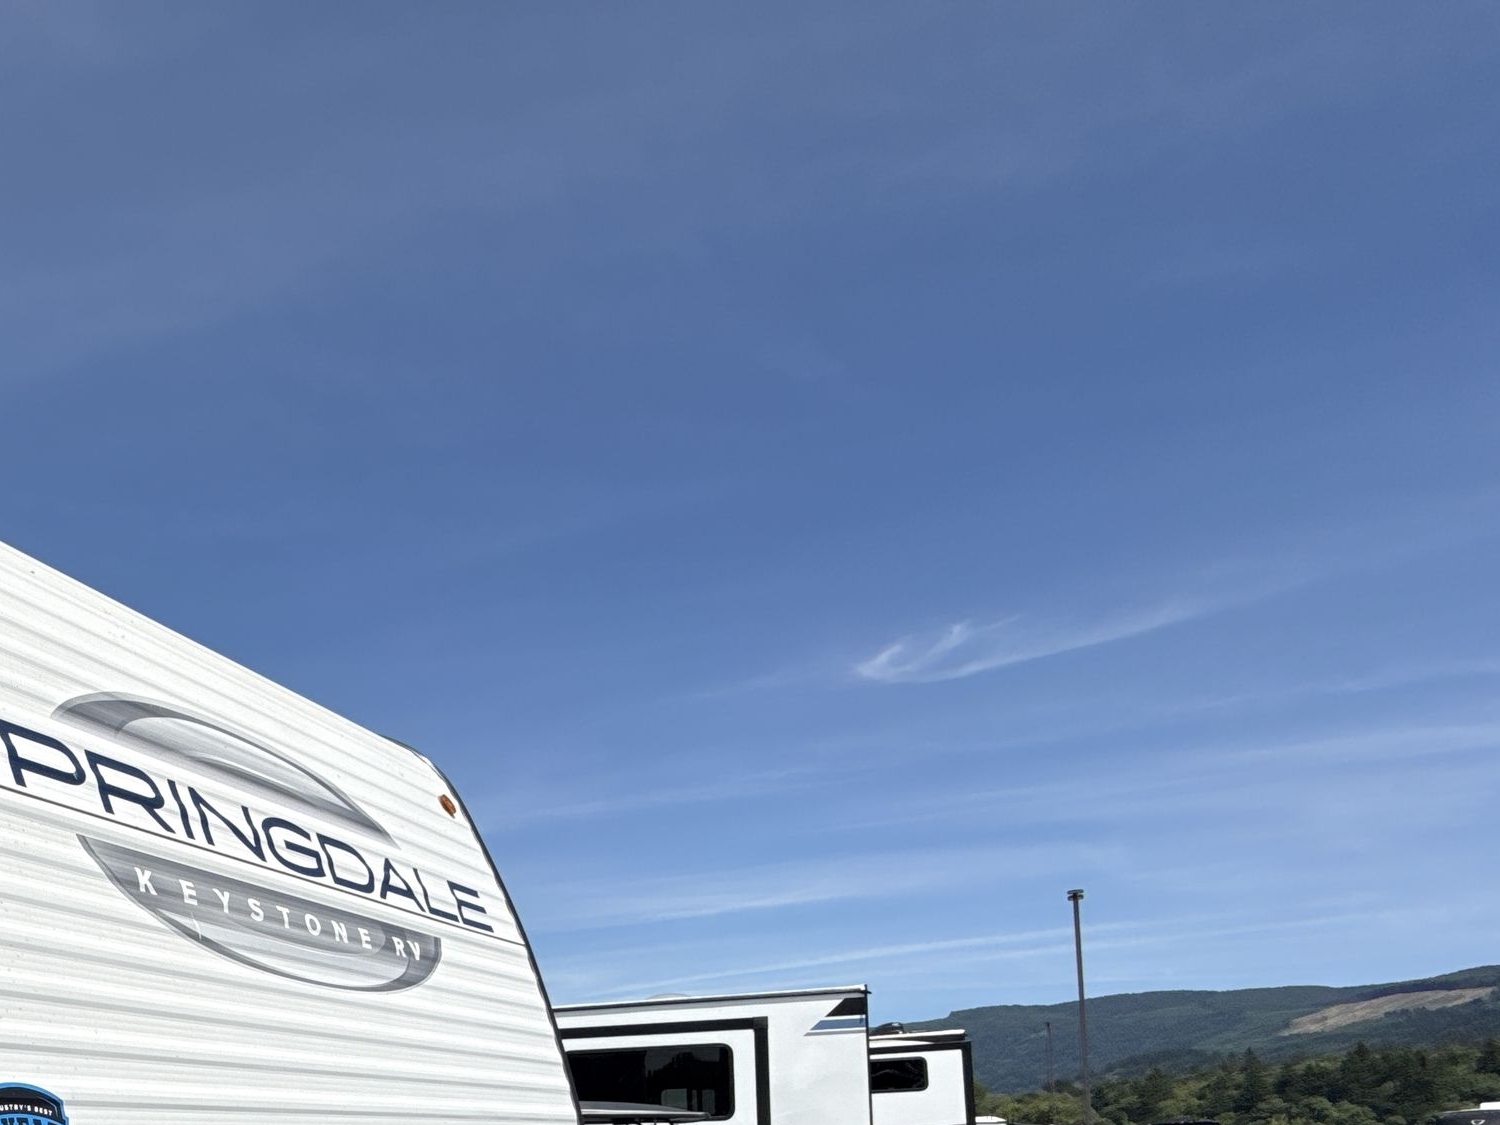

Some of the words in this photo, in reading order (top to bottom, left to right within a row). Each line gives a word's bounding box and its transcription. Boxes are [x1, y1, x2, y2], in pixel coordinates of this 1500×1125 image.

[133, 864, 375, 951] KEYSTONE
[391, 934, 422, 963] RV
[34, 1105, 53, 1116] BEST
